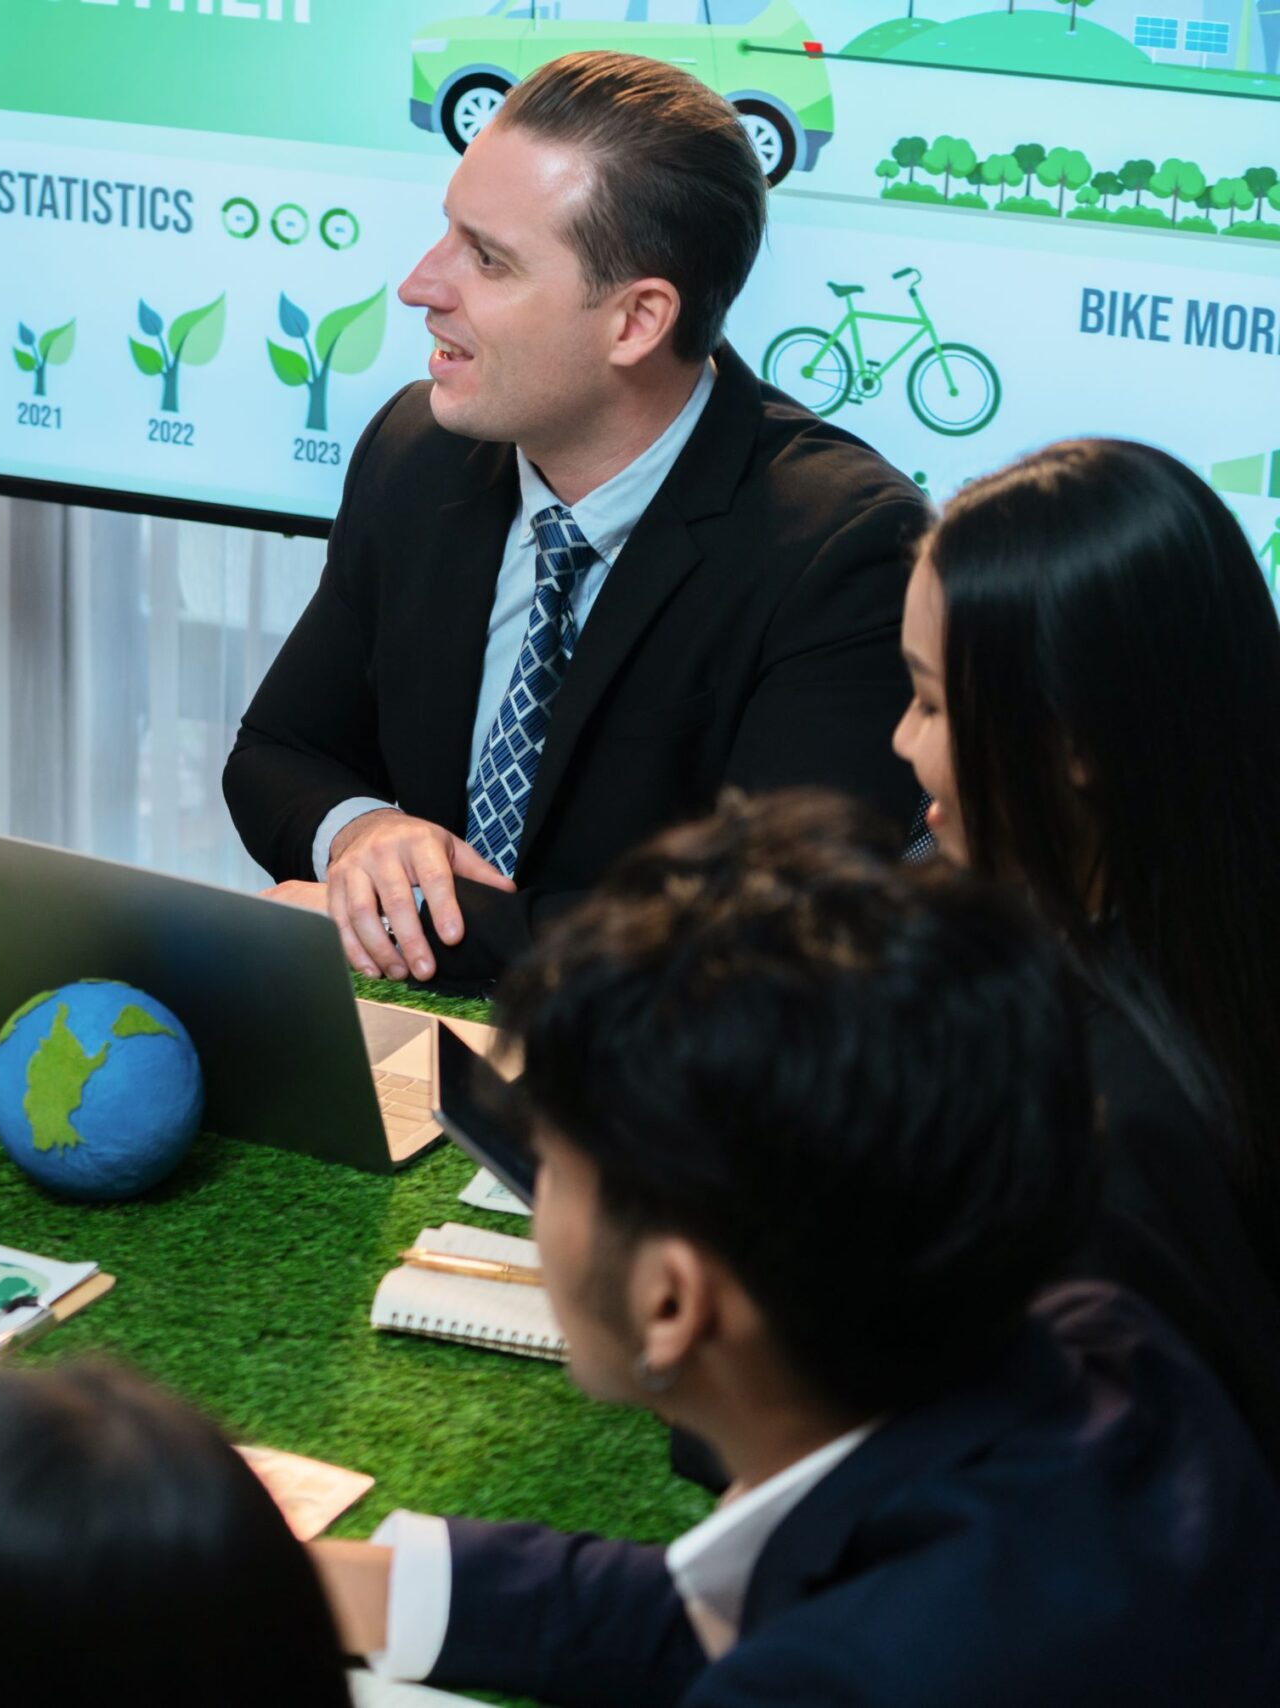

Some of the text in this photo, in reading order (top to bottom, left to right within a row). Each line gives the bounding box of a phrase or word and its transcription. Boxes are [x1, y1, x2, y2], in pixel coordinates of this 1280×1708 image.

[1079, 287, 1280, 356] BIKE MOR
[17, 402, 62, 429] 2021
[148, 418, 195, 446] 2022
[293, 437, 342, 466] 2023
